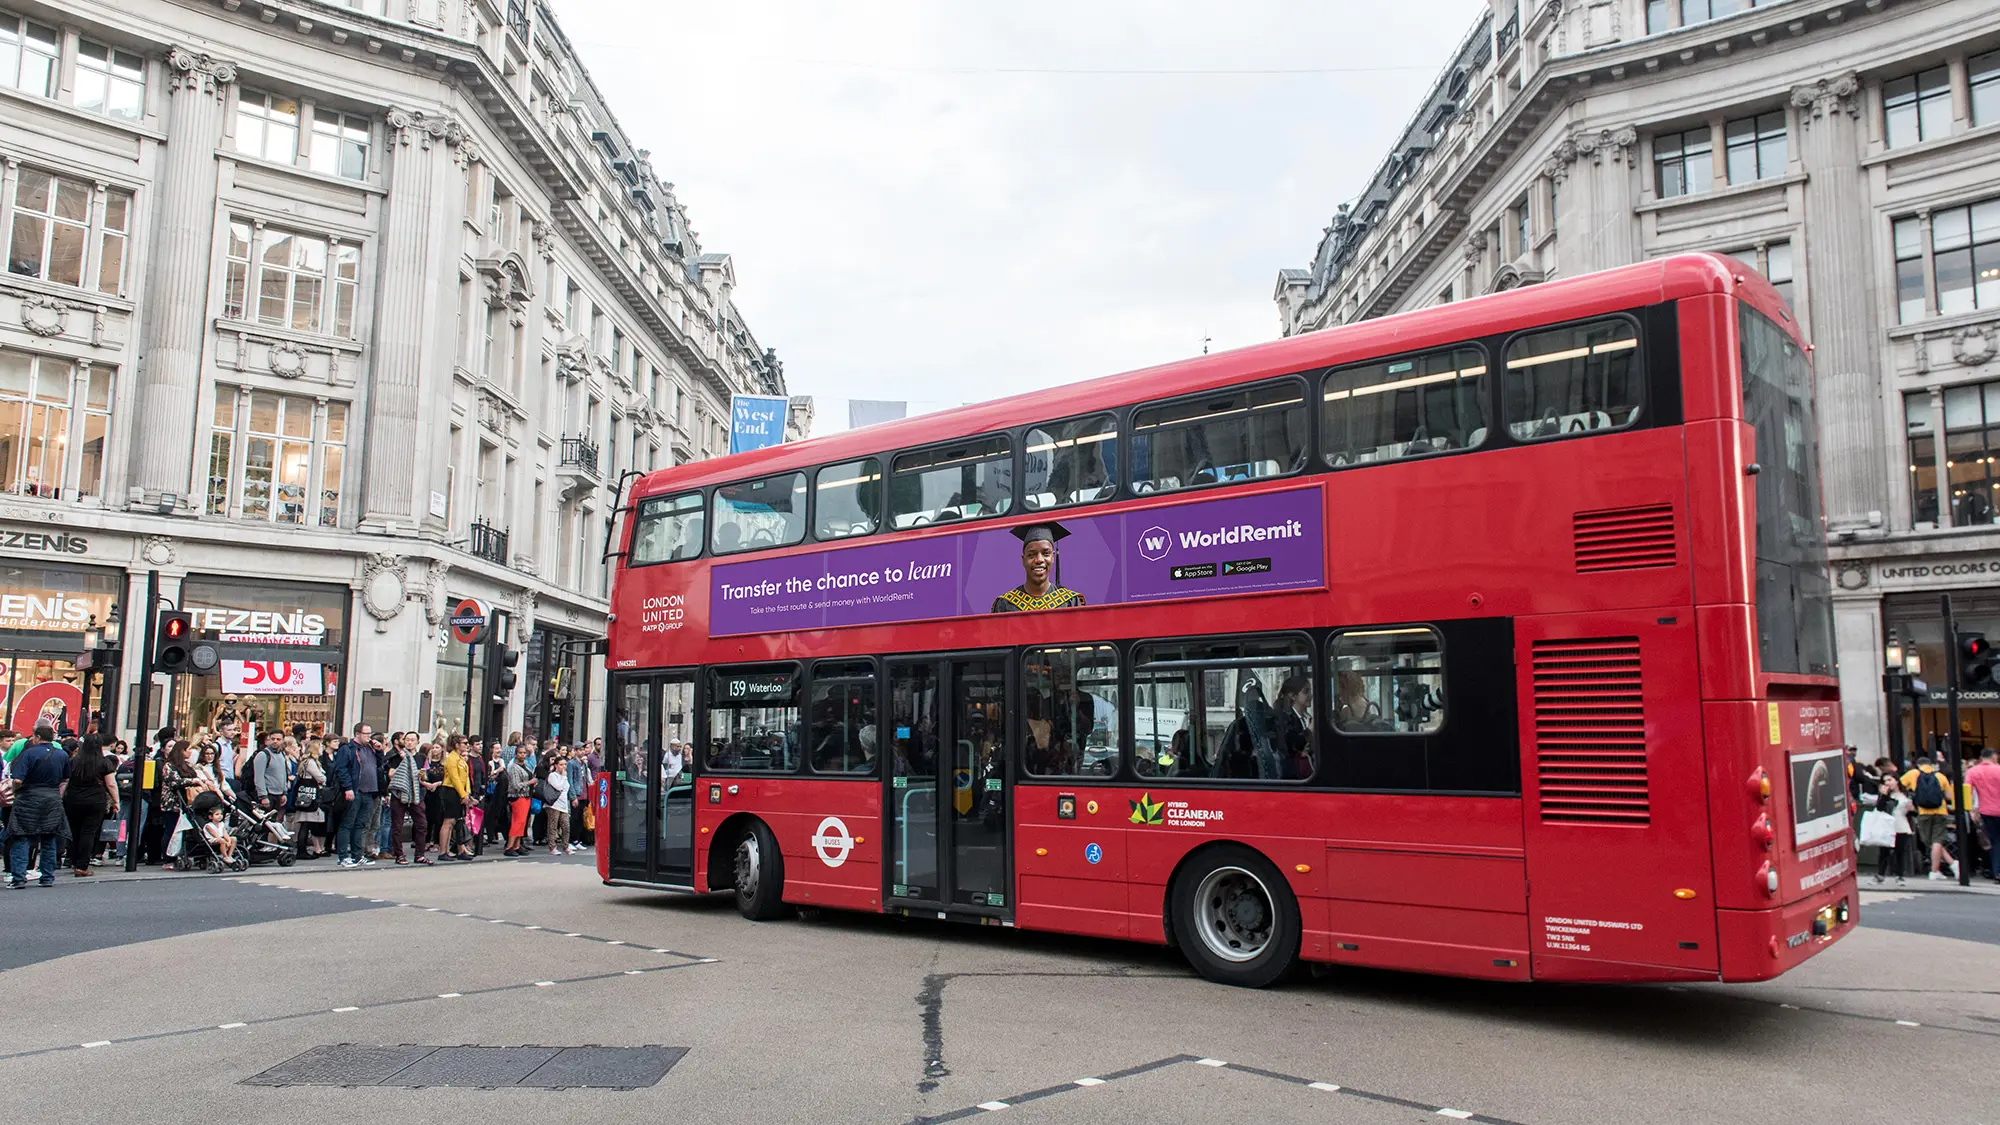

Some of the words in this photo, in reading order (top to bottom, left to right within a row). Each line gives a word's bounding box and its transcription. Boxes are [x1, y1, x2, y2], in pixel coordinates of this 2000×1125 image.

[736, 408, 774, 422] West
[734, 422, 768, 434] End.
[1179, 519, 1302, 549] WorldRemit
[1184, 570, 1197, 578] App
[1197, 569, 1213, 577] Store
[1236, 565, 1256, 573] Google
[1257, 563, 1268, 571] Play
[1882, 566, 1930, 579] UNITED
[1932, 563, 1987, 576] COLORS
[721, 578, 782, 600] Transfer
[785, 575, 812, 593] the
[816, 571, 880, 590] chance
[884, 567, 904, 583] to
[907, 560, 953, 581] learn
[643, 595, 685, 610] LONDON
[750, 606, 764, 615] Take
[765, 605, 776, 614] the
[777, 604, 789, 613] fast
[790, 603, 807, 612] route
[808, 602, 814, 610] &
[815, 600, 831, 610] send
[831, 599, 855, 610] money
[856, 596, 871, 606] with
[872, 591, 914, 604] WorldRemit
[642, 608, 684, 623] UNITED
[450, 617, 484, 626] UNDERGROUND
[642, 624, 658, 632] RATP
[665, 622, 684, 631] GROUP
[729, 681, 746, 697] 139
[749, 682, 782, 694] Waterloo
[1963, 691, 1999, 699] COLORS
[1167, 801, 1189, 809] HYBRID
[1168, 819, 1180, 827] FOR
[824, 838, 841, 846] BUSES
[1545, 917, 1573, 925] LONDON
[1598, 921, 1630, 929] BUSWAYS
[1545, 925, 1590, 934] TWICKENHAM
[1546, 933, 1561, 941] TW2
